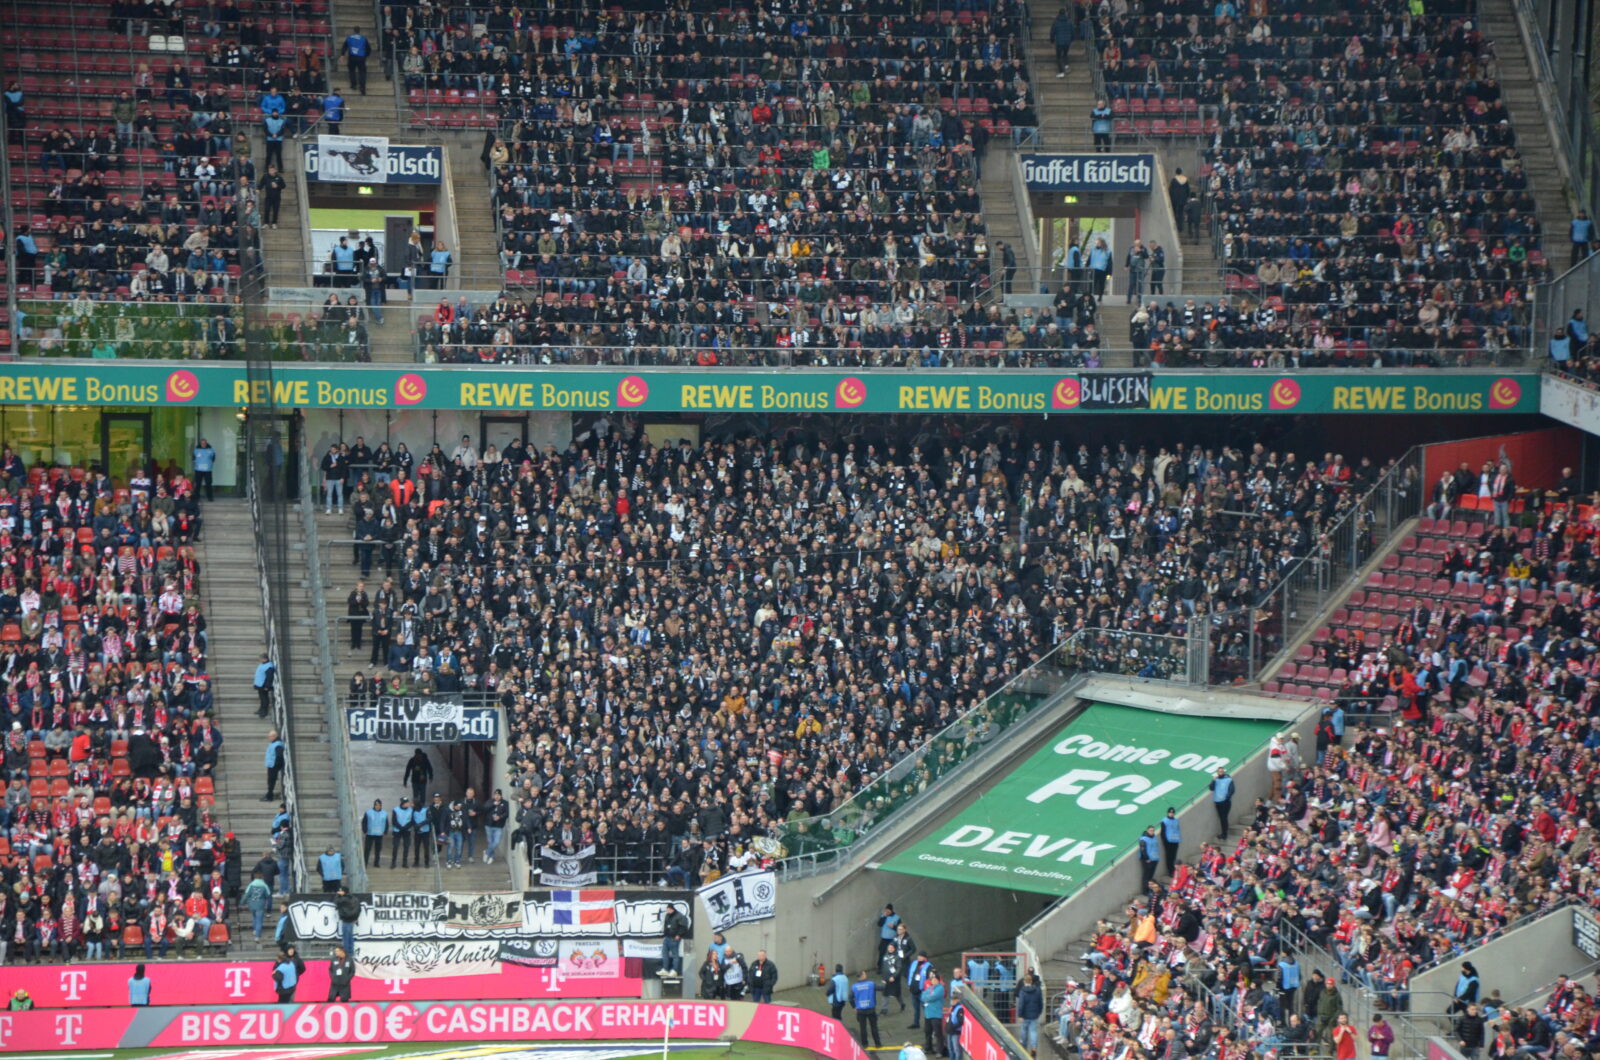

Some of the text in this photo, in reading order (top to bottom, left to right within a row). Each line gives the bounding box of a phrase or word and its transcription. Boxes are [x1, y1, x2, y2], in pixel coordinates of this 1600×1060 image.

[387, 151, 439, 179] ölsch
[1083, 159, 1150, 186] Kölsch
[0, 377, 159, 402] REWE Bonus
[233, 380, 388, 406] REWE Bonus
[460, 383, 610, 408] REWE Bonus
[681, 384, 829, 409] REWE Bonus
[899, 386, 1046, 410] REWE Bonus
[1196, 386, 1263, 410] Bonus
[1333, 386, 1482, 410] REWE Bonus
[377, 696, 421, 721] ELV
[377, 721, 459, 742] UNITED
[1053, 733, 1231, 774] Come on
[1026, 768, 1182, 815] FC!
[938, 824, 1117, 866] DEVK
[374, 894, 430, 908] JUGEND
[374, 908, 432, 922] KOLLEKTIV
[441, 943, 498, 968] Unity
[181, 1014, 231, 1042] BIS
[240, 1013, 280, 1040] ZU
[426, 1005, 594, 1034] CASHBACK
[601, 1003, 726, 1028] ERHALTEN
